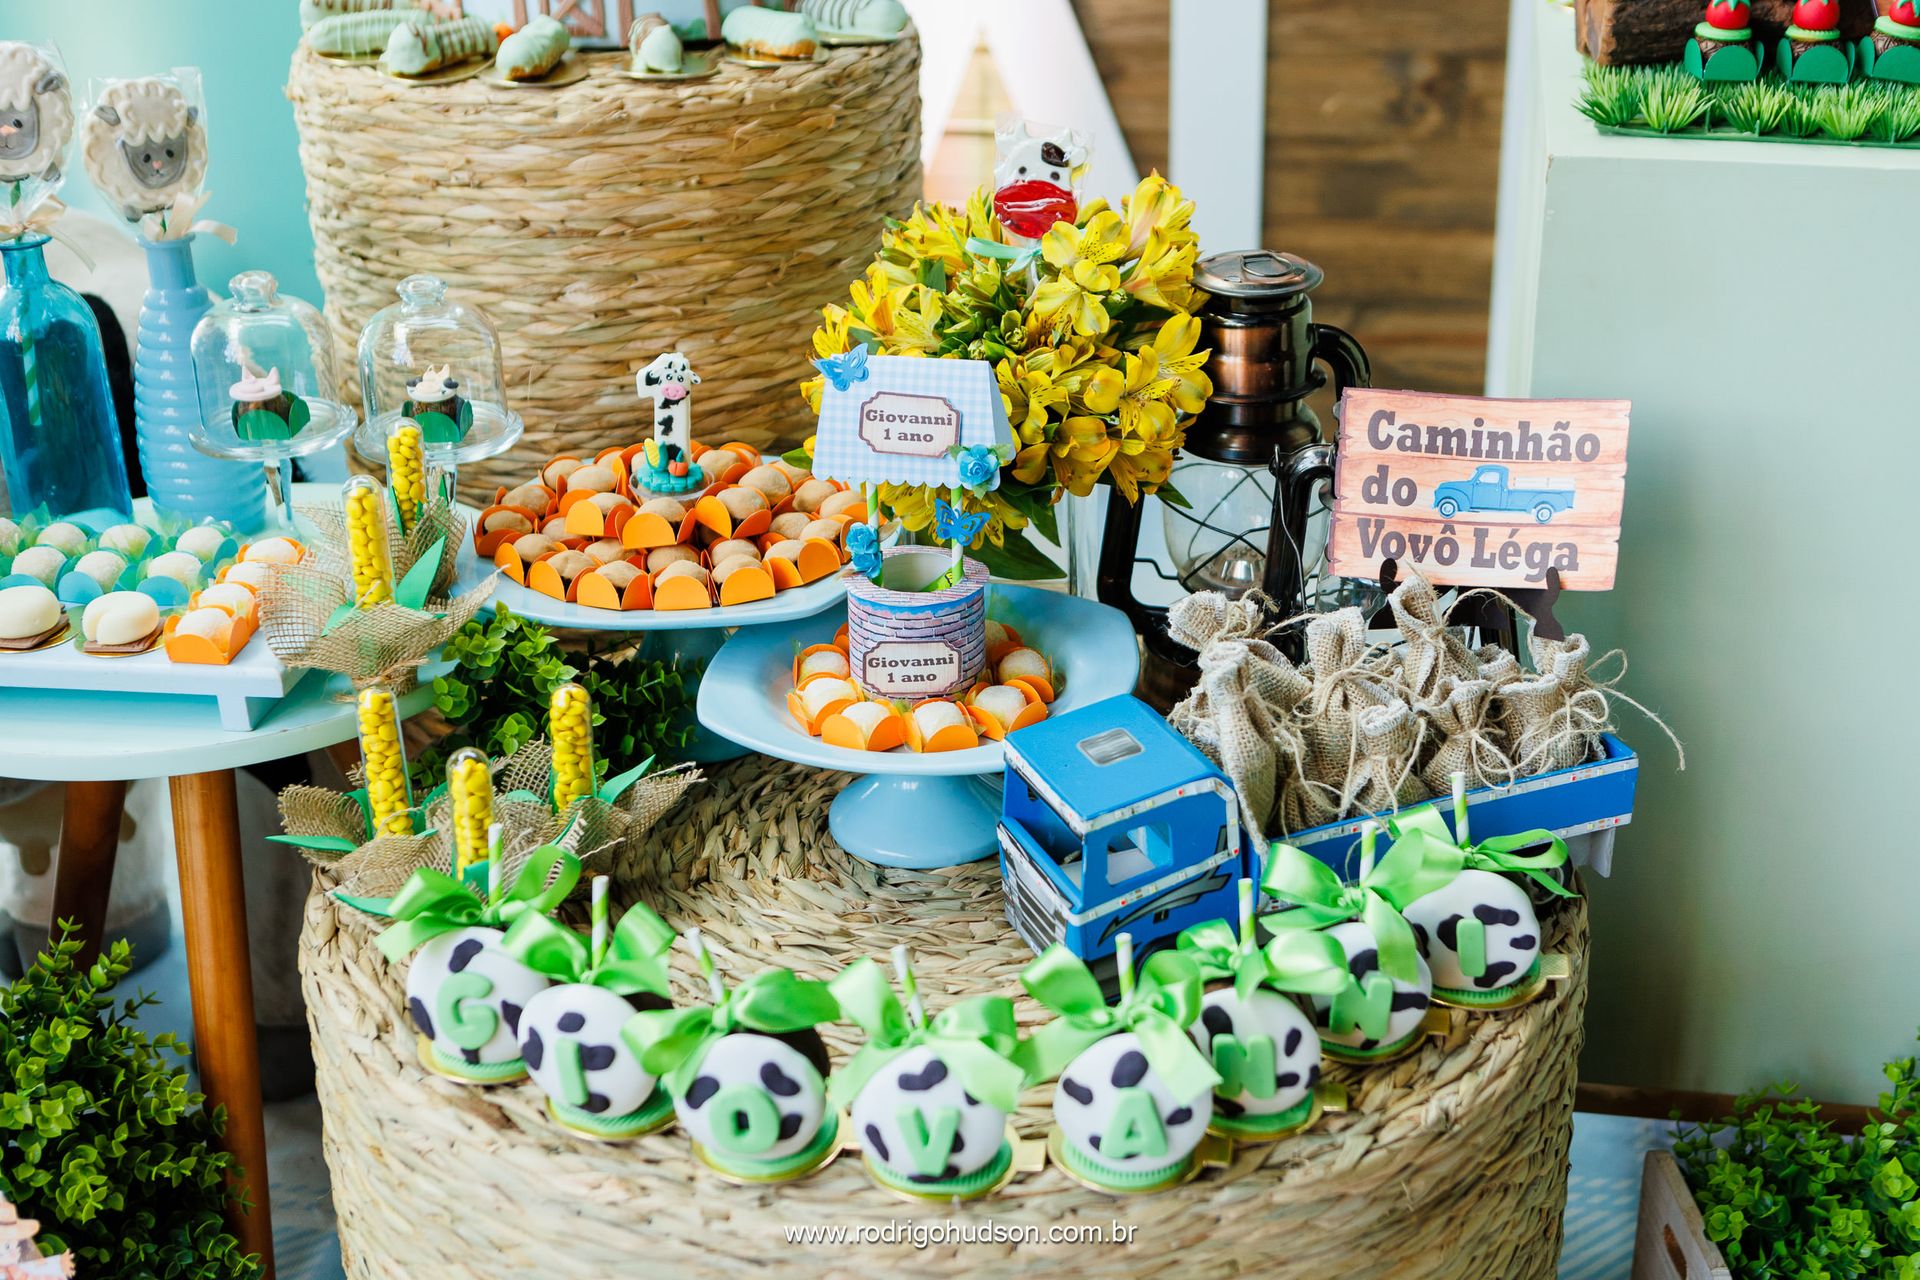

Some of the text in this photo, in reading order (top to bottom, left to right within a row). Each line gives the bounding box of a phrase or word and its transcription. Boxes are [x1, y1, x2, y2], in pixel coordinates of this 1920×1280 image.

[865, 409, 953, 426] Giovanni
[883, 428, 934, 443] 1 ano
[1367, 409, 1601, 463] Caminhão
[1361, 464, 1418, 507] do
[1356, 517, 1579, 582] Vovô Léga
[868, 653, 955, 668] Giovanni
[887, 672, 937, 683] 1 ano
